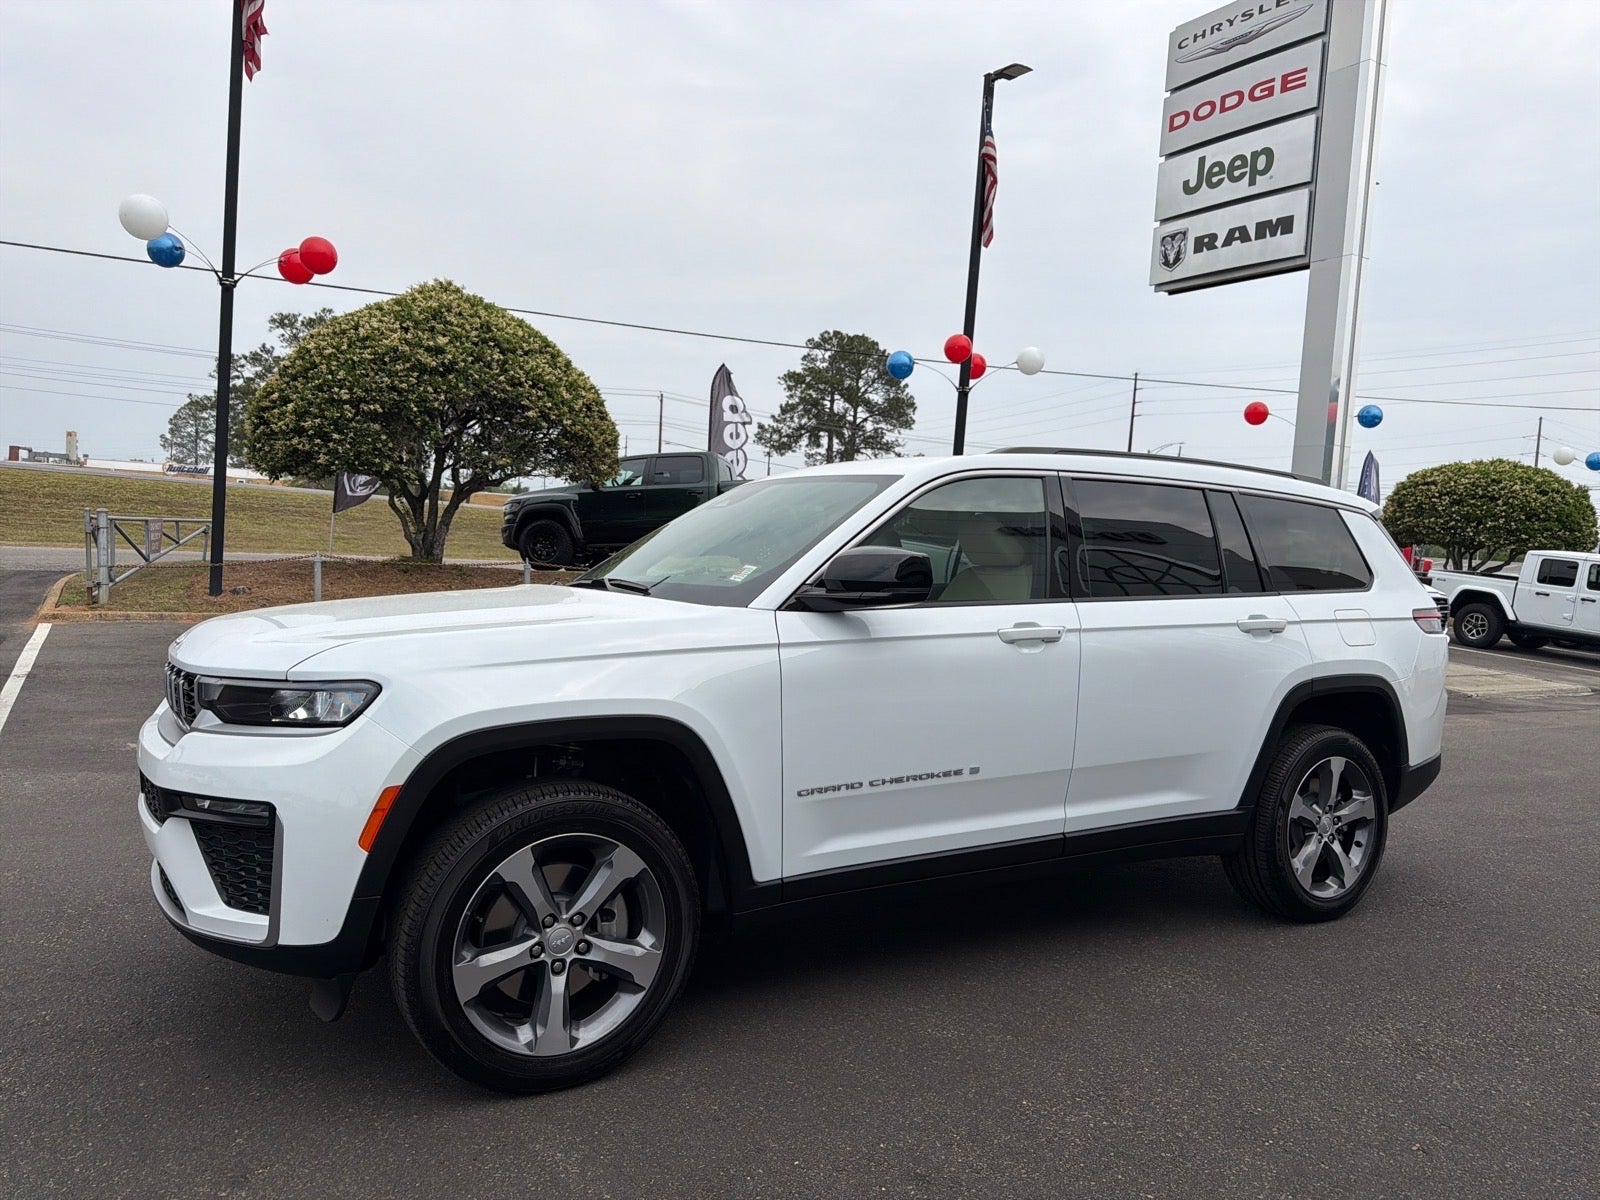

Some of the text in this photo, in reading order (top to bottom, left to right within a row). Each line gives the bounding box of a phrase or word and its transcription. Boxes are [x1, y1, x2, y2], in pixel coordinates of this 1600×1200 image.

[1177, 0, 1306, 50] CHRYSLE
[1168, 67, 1308, 133] DODGE
[1182, 146, 1275, 196] Jeep
[1192, 214, 1295, 254] RAM
[721, 394, 753, 480] eep
[796, 781, 864, 797] GRAND
[868, 768, 964, 787] CHEROKEE
